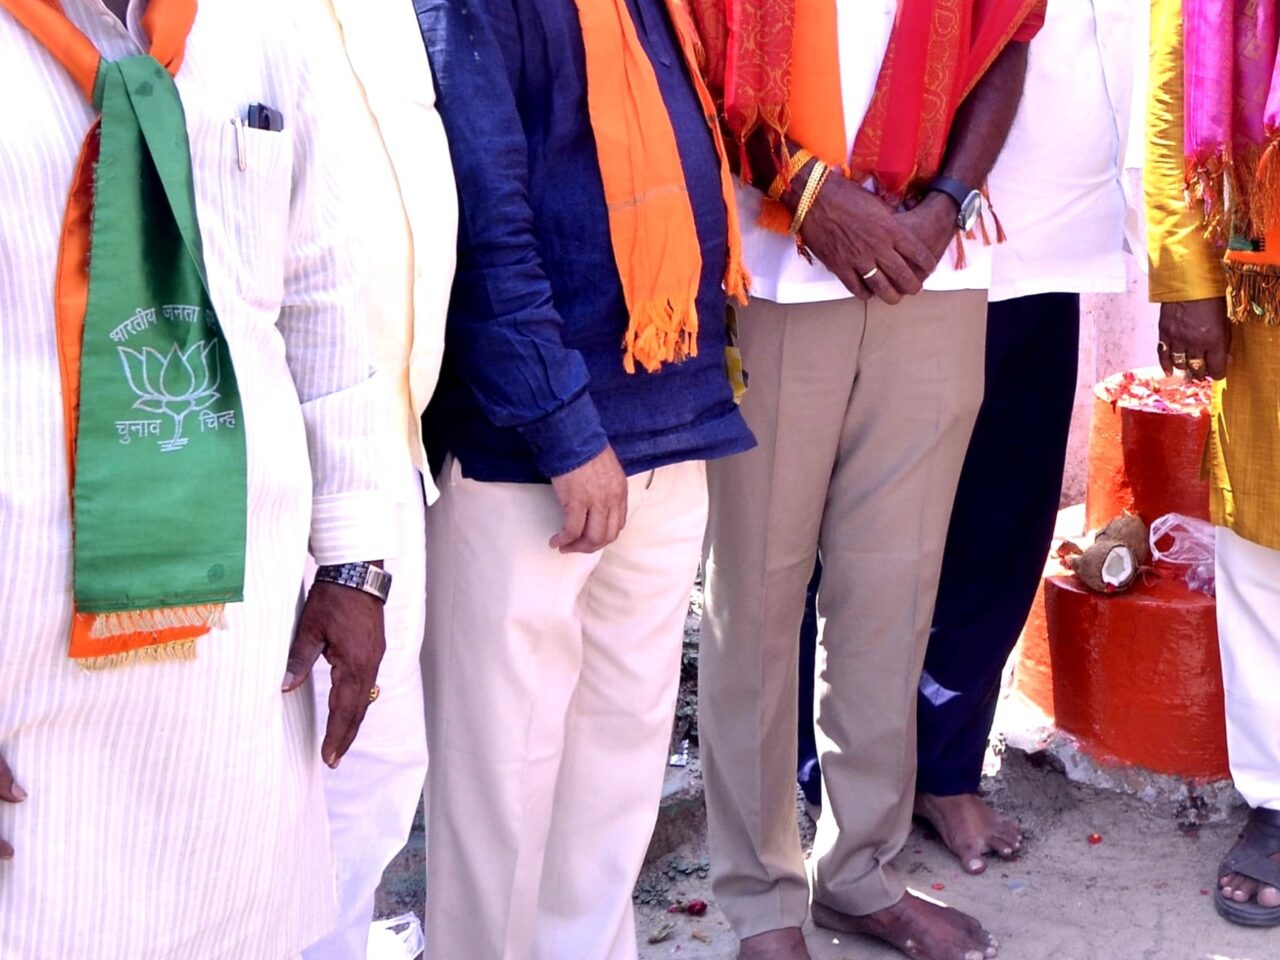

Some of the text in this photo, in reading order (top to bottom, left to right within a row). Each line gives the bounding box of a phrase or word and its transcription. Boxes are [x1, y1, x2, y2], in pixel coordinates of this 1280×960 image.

[109, 308, 157, 342] भारतीय
[163, 304, 200, 323] जनता
[114, 409, 236, 444] चुनाव चिन्ह
